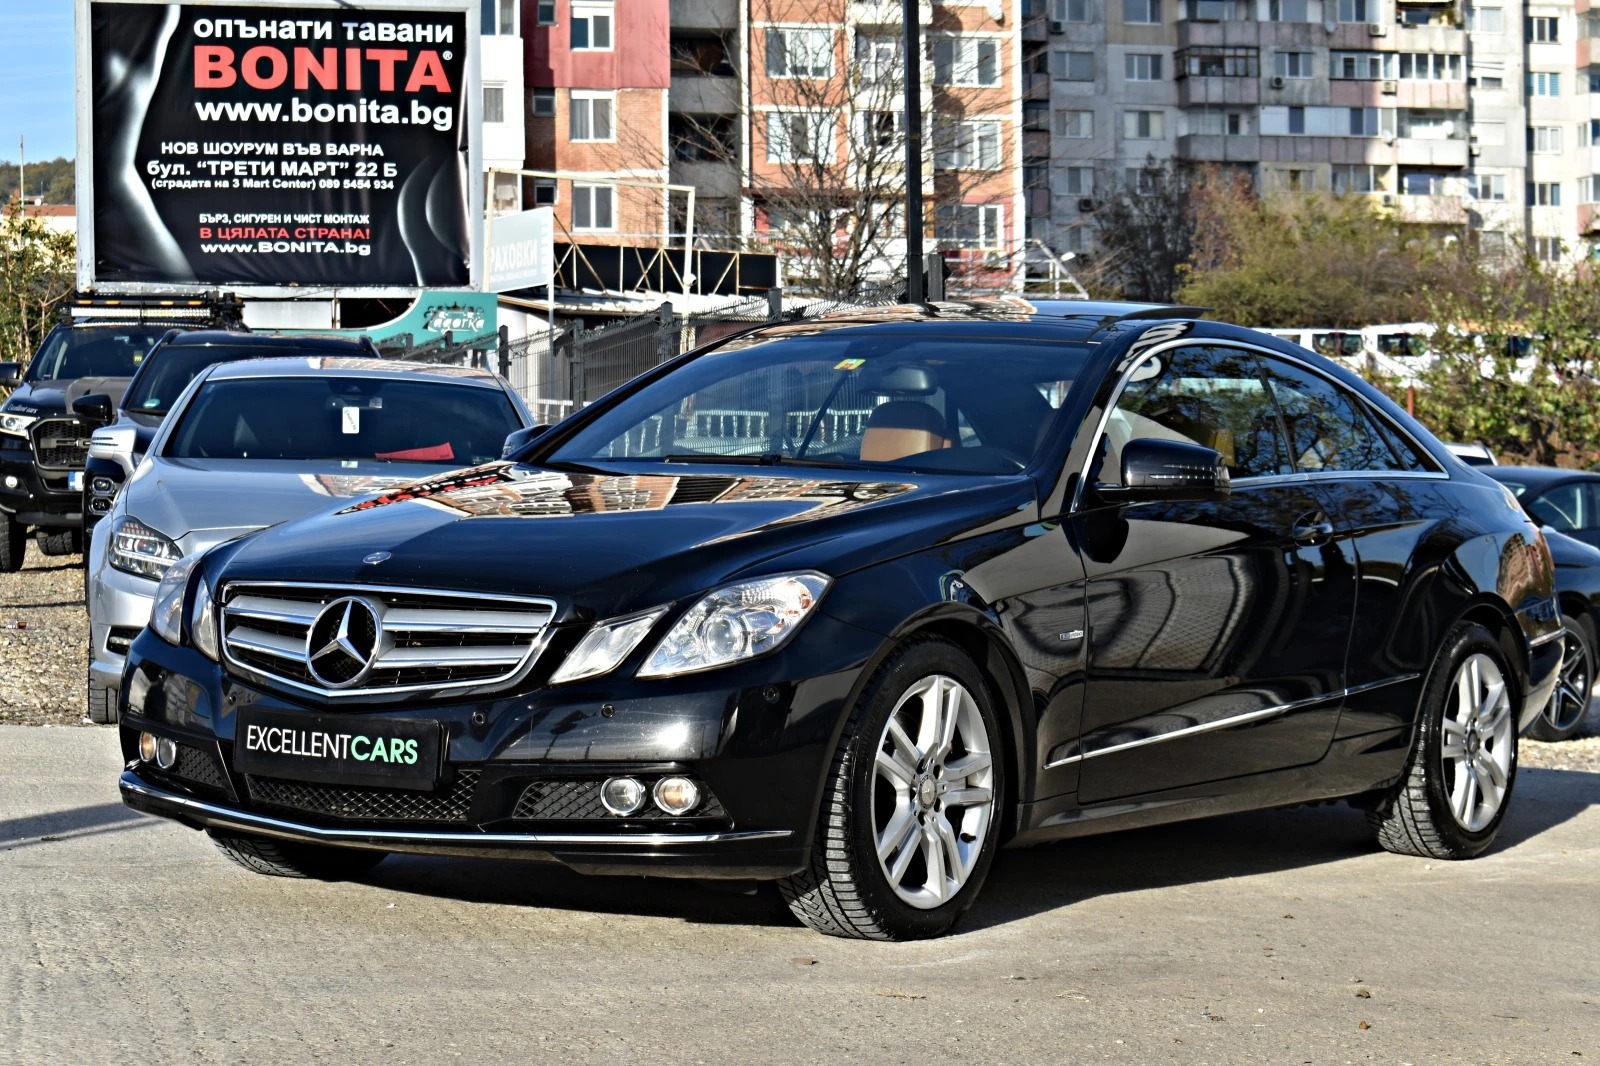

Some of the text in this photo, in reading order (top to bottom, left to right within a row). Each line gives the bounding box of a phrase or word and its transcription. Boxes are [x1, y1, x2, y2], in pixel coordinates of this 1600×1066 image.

[194, 19, 452, 43] опънати тавани
[195, 97, 452, 131] www.bonita.bg
[162, 142, 384, 156] НОВ ШОУРУМ ВЪВ ВАРНА
[147, 160, 190, 179] бул.
[355, 162, 377, 176] 22
[384, 163, 397, 177] Б
[152, 177, 394, 190] (сградата на 3 Mart Center) 089 5454 934
[199, 213, 369, 224] БЪРЗ, СИГУРЕН И ЧИСТ МОНТАЖ
[200, 227, 370, 240] В ЦЯЛАТА СТРАНА!
[201, 242, 370, 256] www.BONITA.bg
